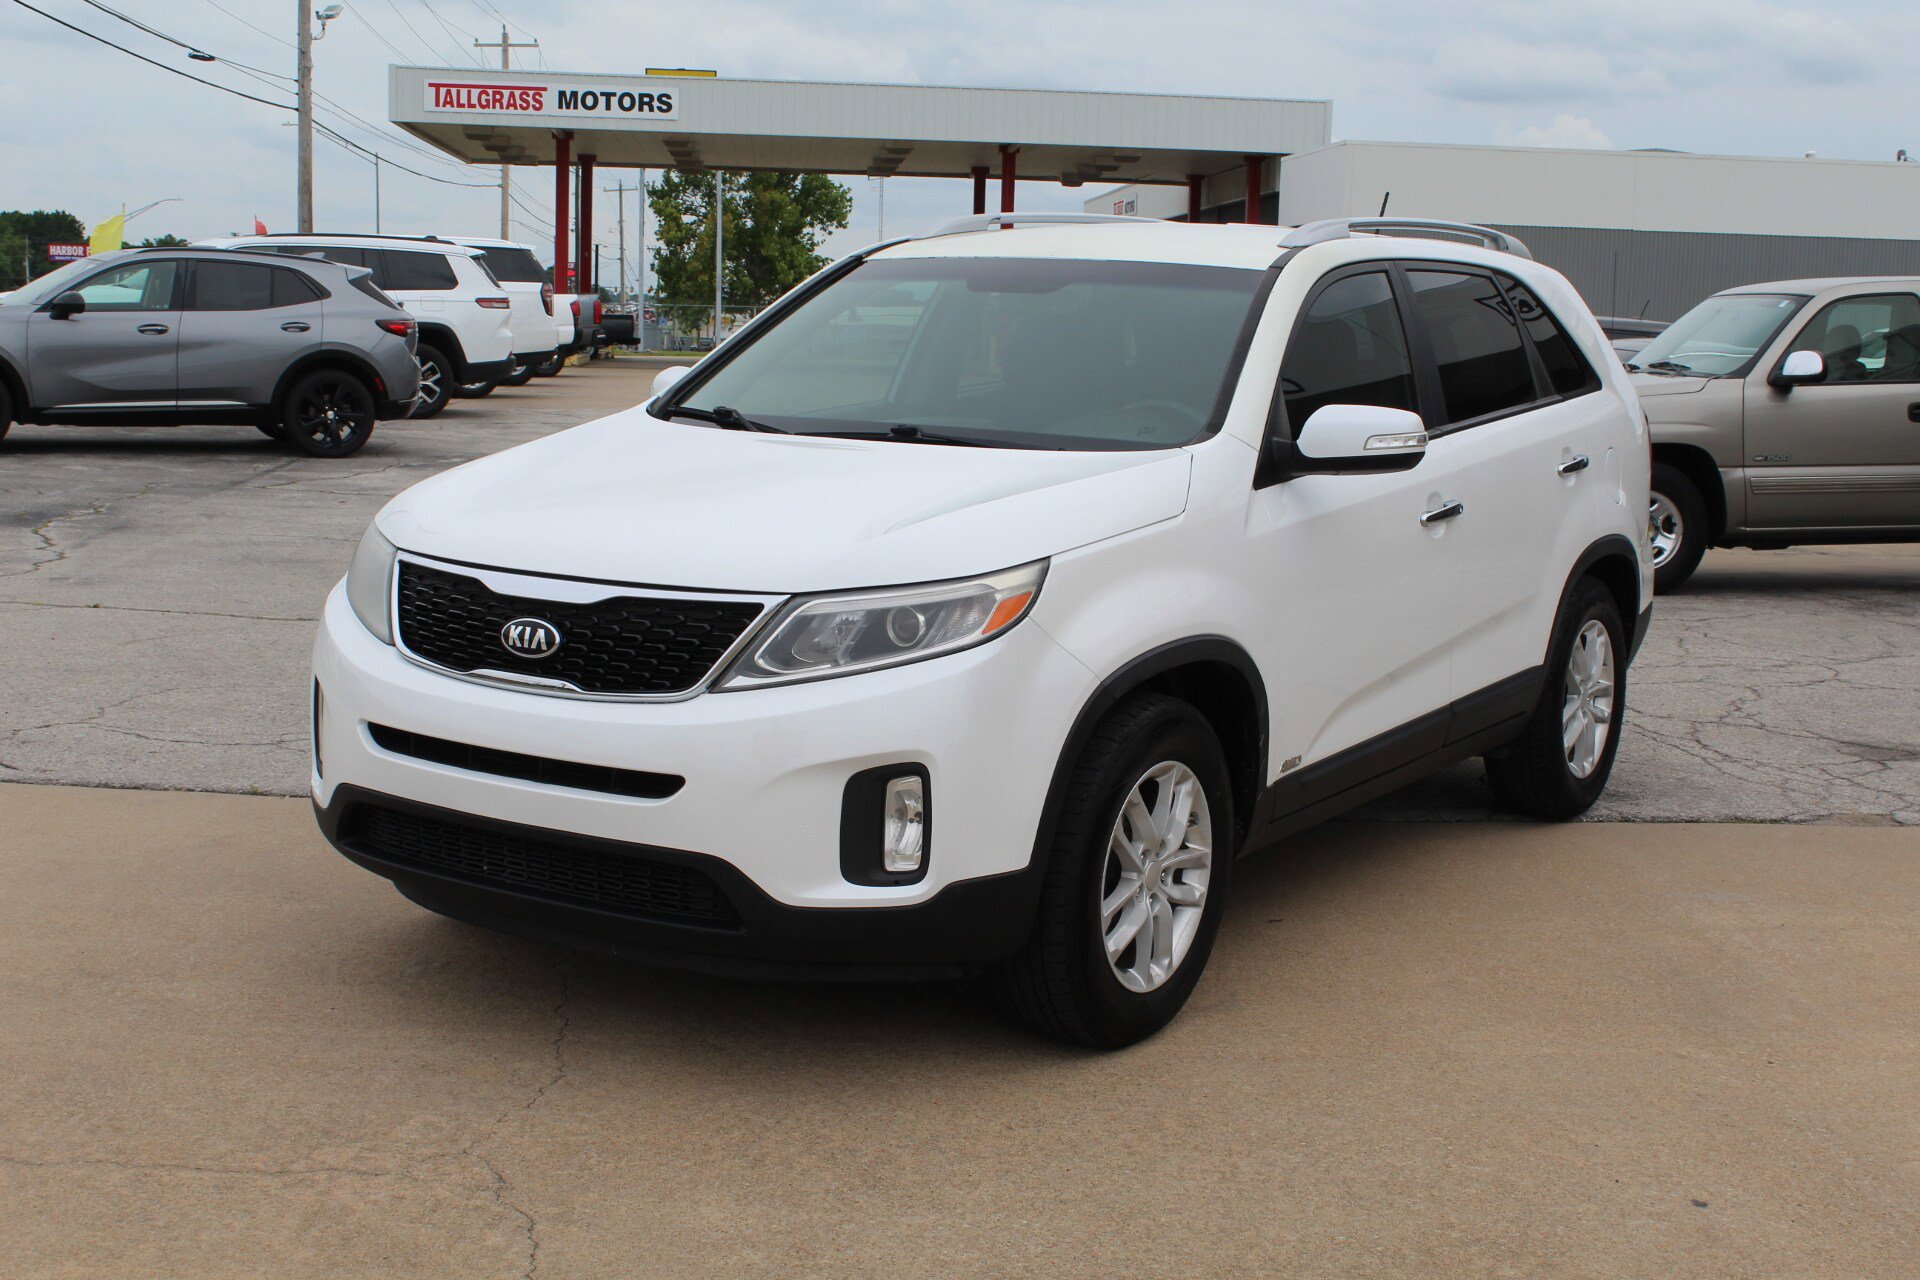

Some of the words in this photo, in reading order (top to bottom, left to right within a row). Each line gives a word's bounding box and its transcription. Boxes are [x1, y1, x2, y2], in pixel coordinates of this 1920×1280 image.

[428, 83, 547, 111] TALLGRASS
[558, 90, 673, 113] MOTORS
[50, 245, 84, 256] HARBOR
[508, 625, 548, 651] KIA
